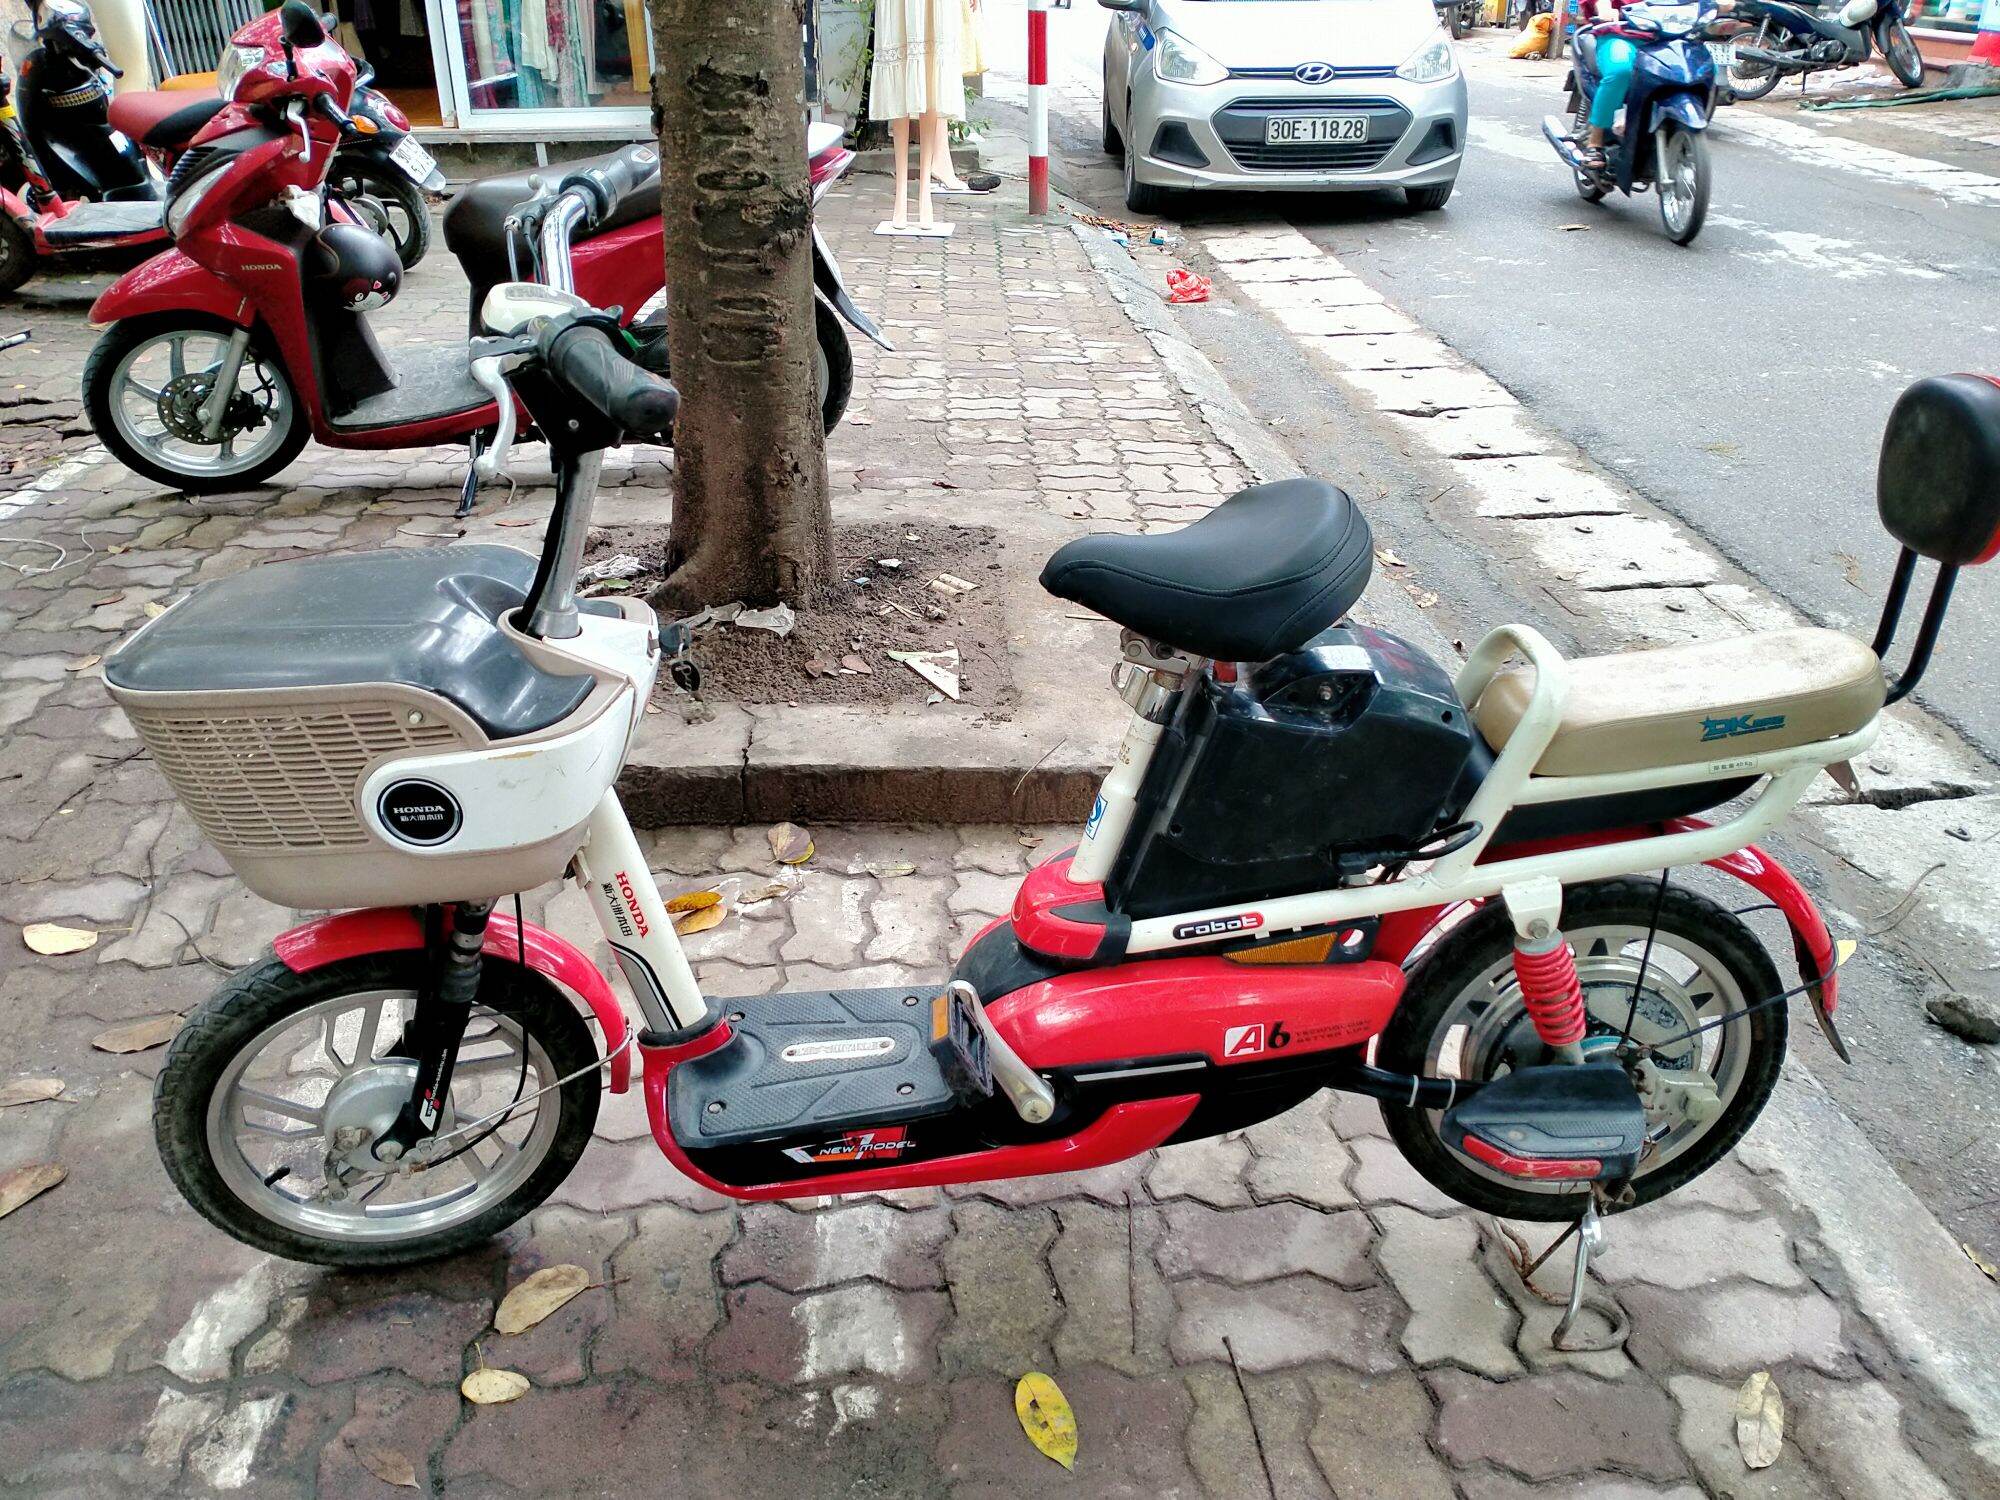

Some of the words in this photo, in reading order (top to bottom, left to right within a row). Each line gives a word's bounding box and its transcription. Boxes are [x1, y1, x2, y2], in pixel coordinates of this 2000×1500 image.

[1270, 120, 1365, 140] 30E-118.28
[393, 805, 446, 814] HONDA
[601, 882, 633, 937] 新大洲本田
[615, 871, 649, 939] HONDA
[820, 1145, 855, 1156] NEW
[860, 1140, 917, 1152] MODEL
